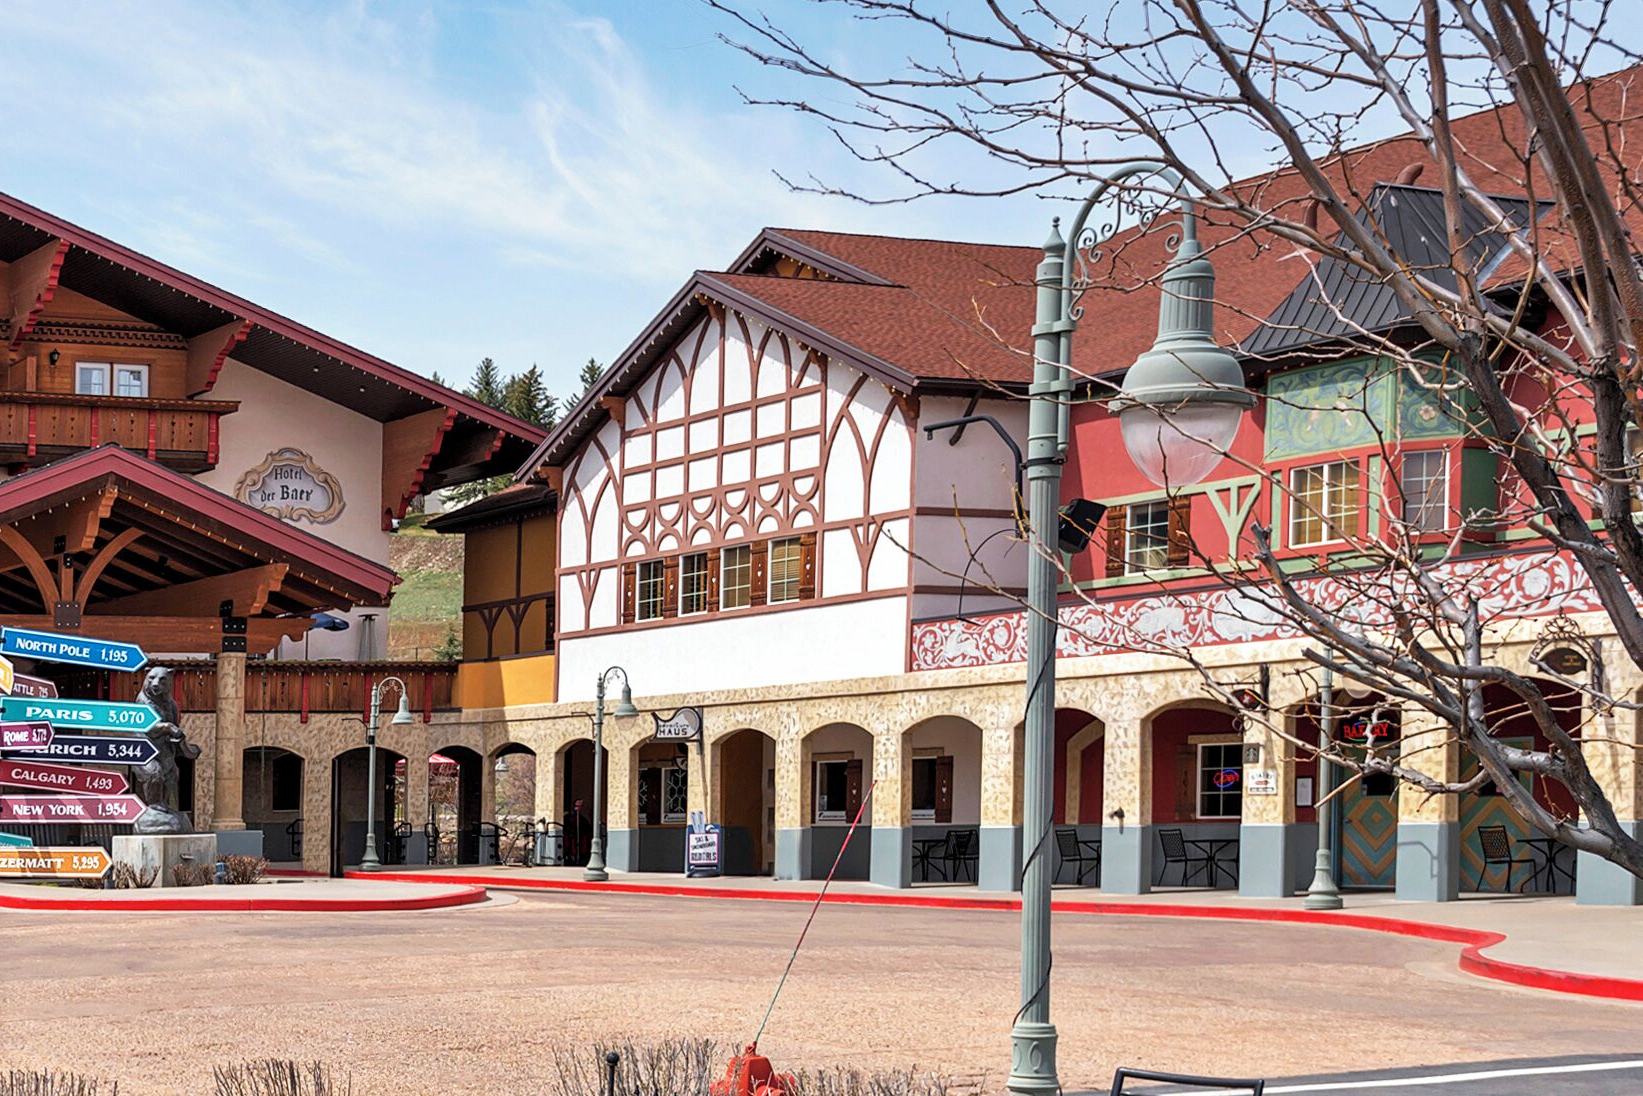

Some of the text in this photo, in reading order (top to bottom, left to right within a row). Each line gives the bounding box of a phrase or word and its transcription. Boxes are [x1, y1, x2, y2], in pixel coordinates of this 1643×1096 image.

[274, 468, 302, 480] Hotel
[261, 484, 313, 502] der Baer
[15, 637, 128, 663] NORTH POLE 1,195
[13, 682, 34, 696] ATTLE
[26, 707, 145, 724] PARIS 5,070
[3, 730, 29, 746] ROME
[659, 728, 688, 736] HAUS
[107, 744, 143, 758] 5,344
[11, 768, 113, 790] CALGARY 1,493
[13, 803, 128, 817] NEW YORK 1,954
[72, 856, 100, 871] 5,295
